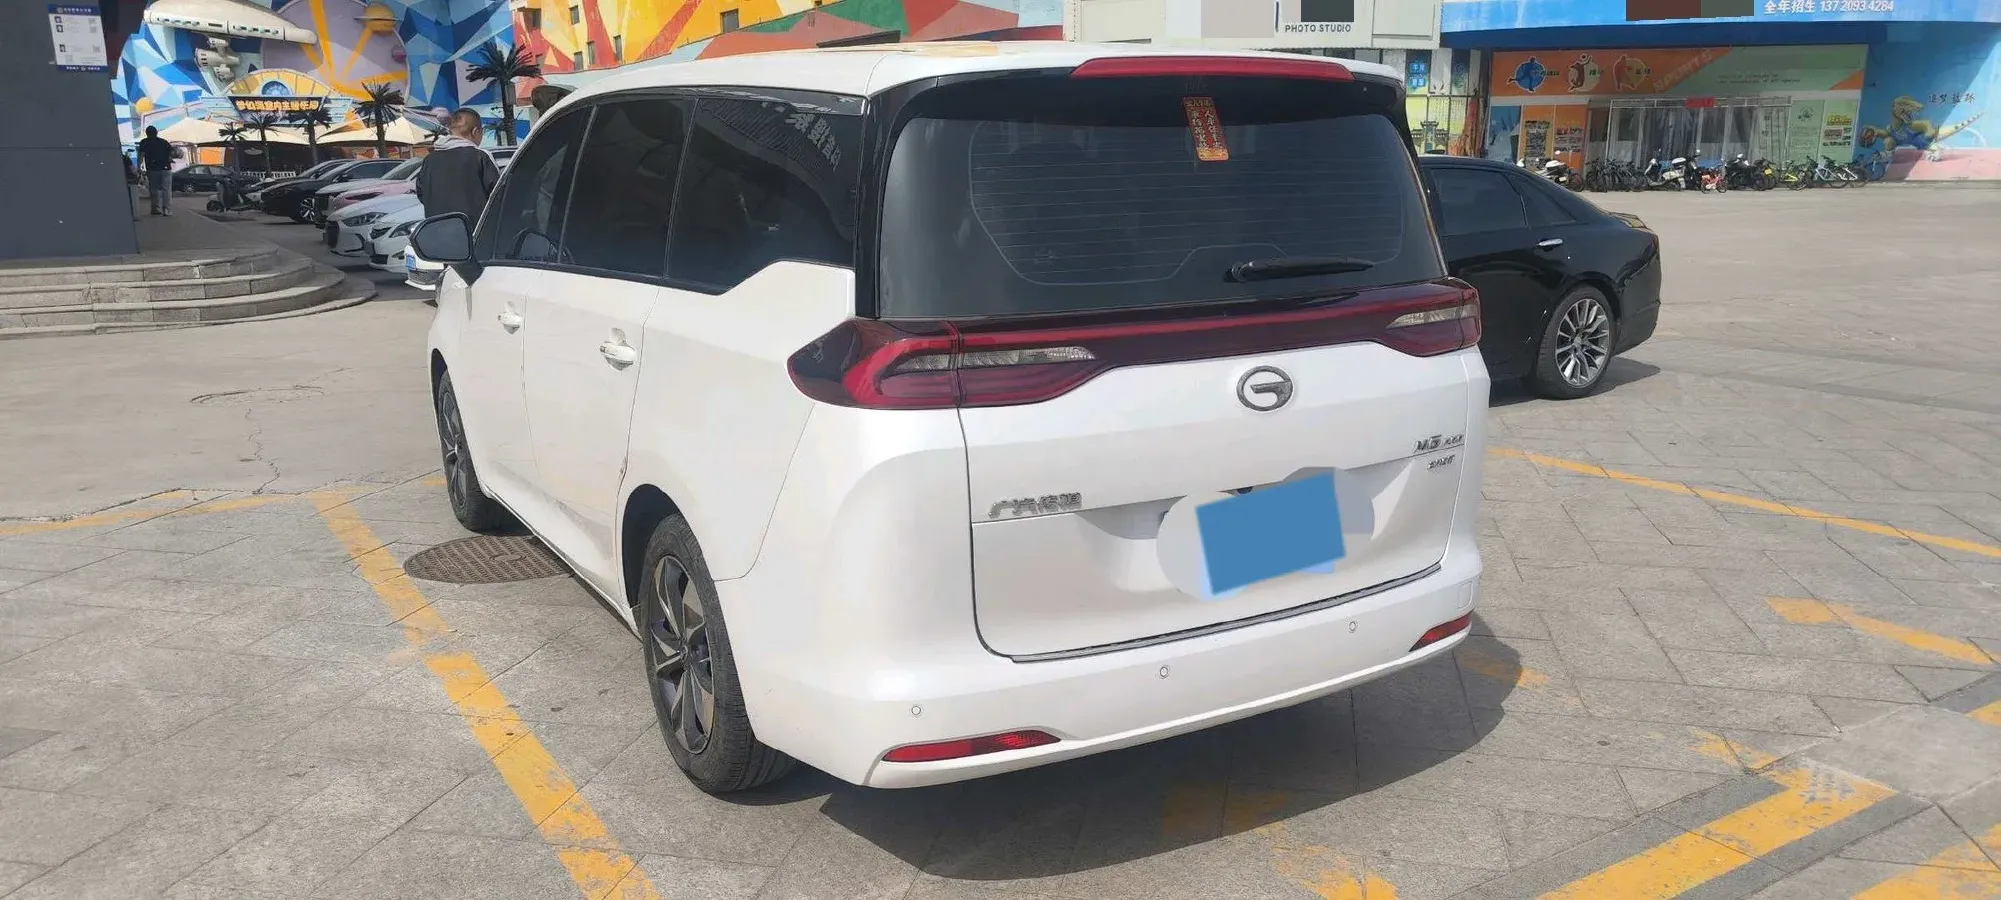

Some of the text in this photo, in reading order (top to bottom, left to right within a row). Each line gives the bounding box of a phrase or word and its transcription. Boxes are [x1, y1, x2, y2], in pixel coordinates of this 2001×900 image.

[1764, 0, 1816, 14] 全年招生
[1285, 24, 1352, 33] PHOTO STUDIO
